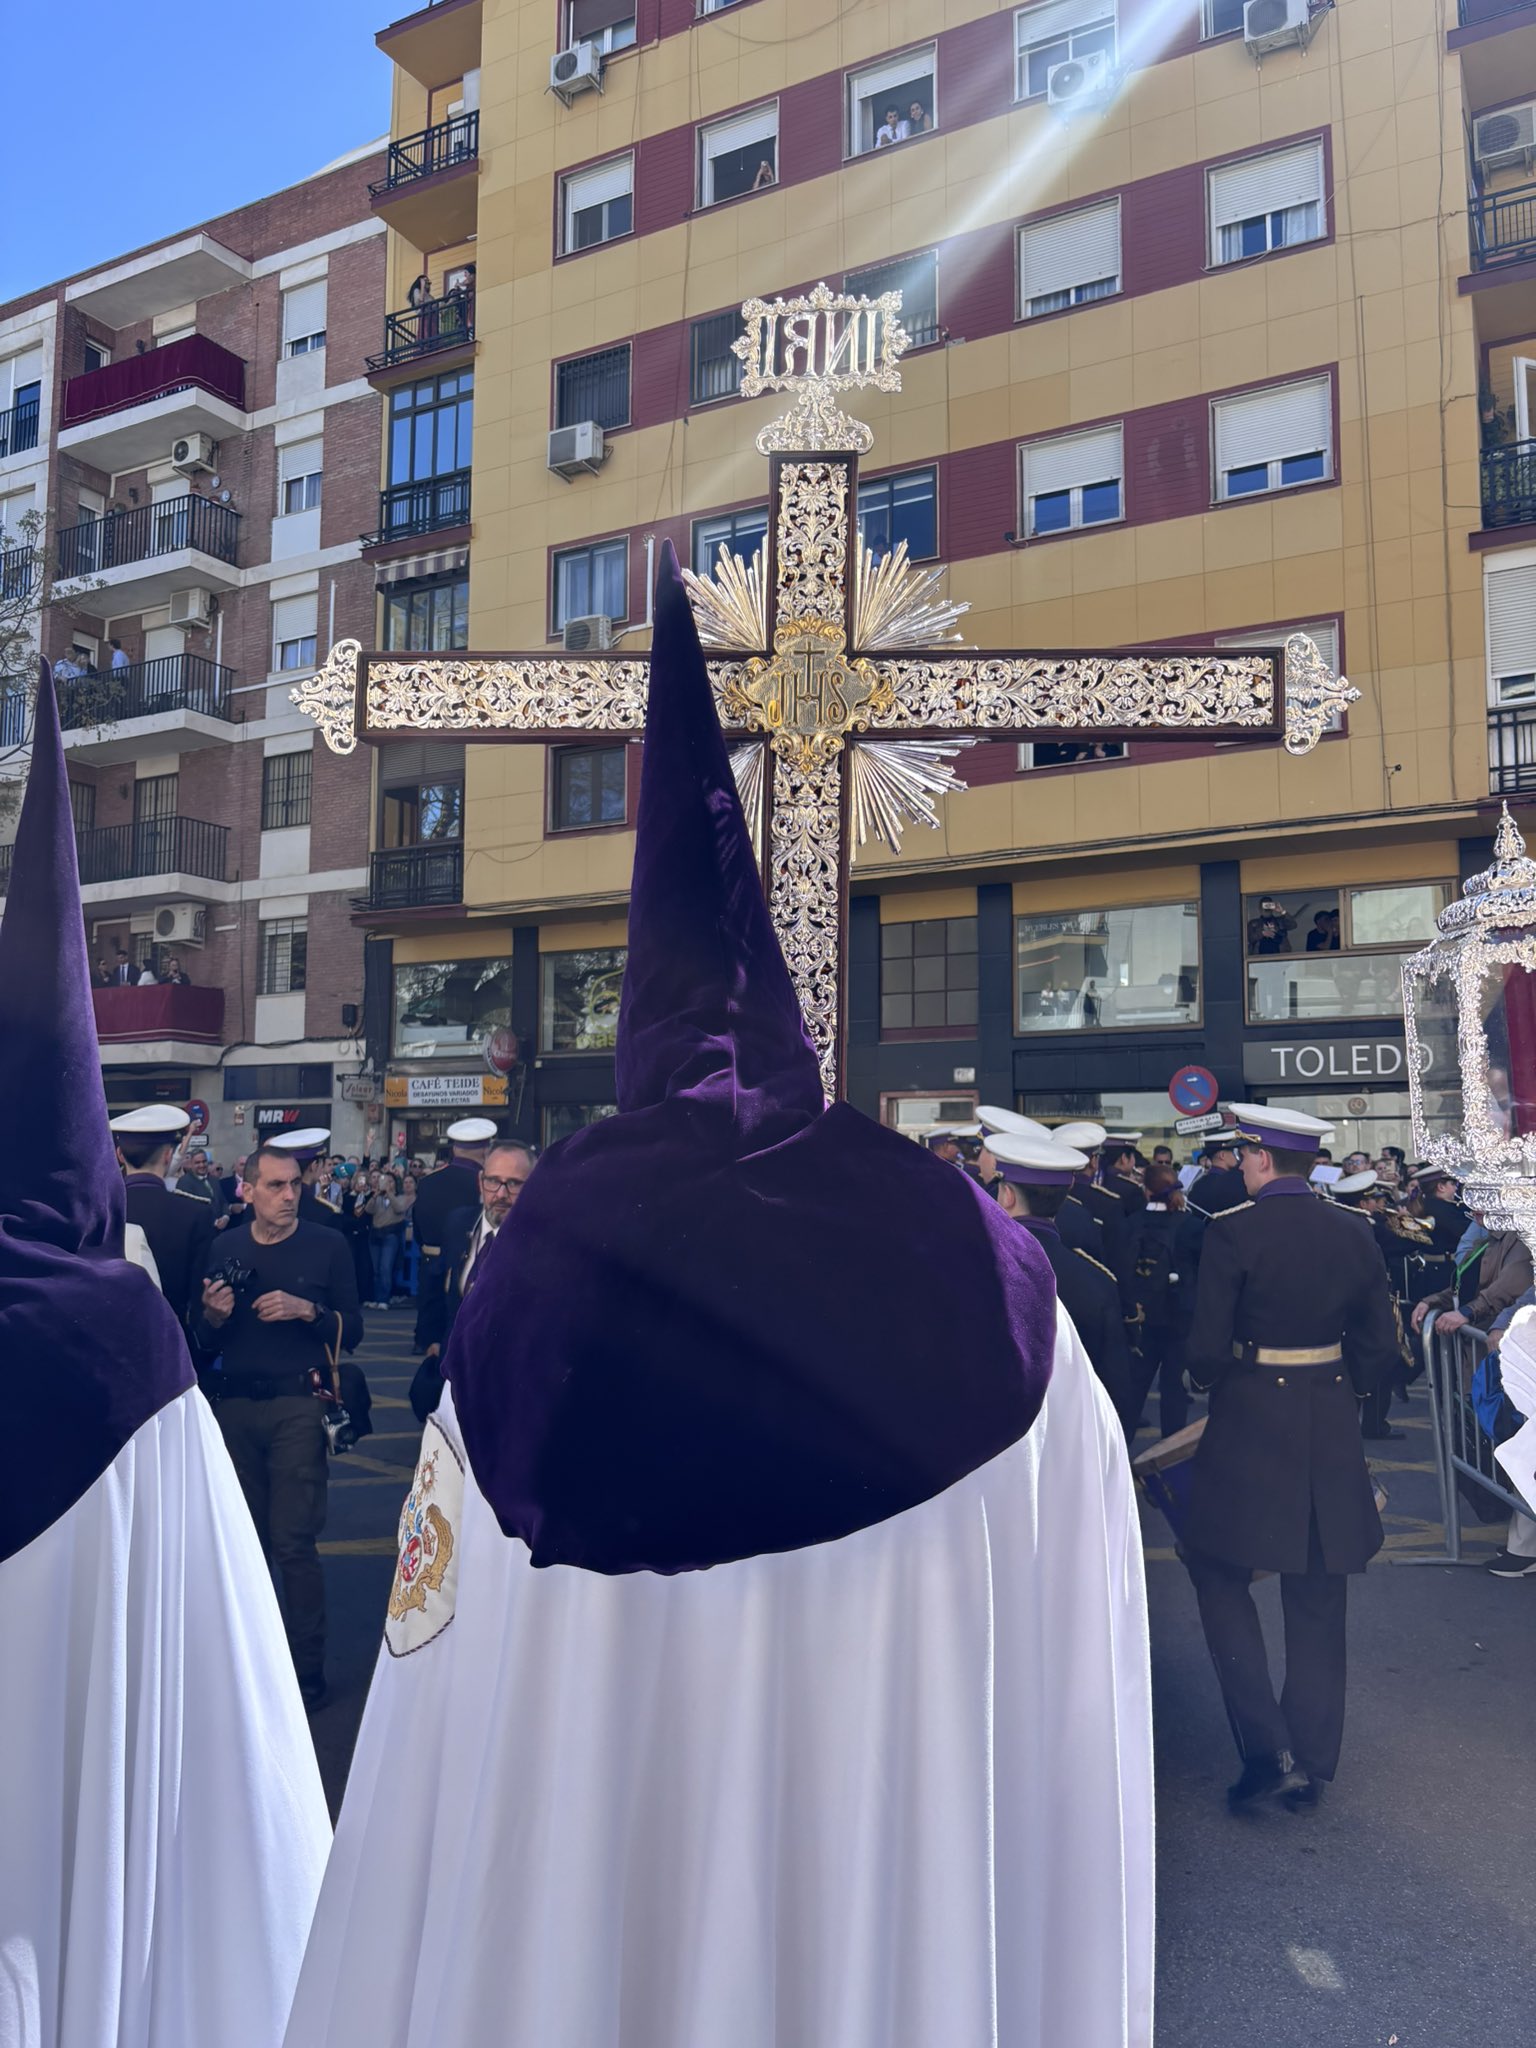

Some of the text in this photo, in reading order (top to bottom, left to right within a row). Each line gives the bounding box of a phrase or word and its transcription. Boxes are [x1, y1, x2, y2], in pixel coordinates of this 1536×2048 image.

[411, 1077, 480, 1090] CAFÉ TEIDE
[413, 1089, 479, 1098] DESAYUNOS VARIADOS
[421, 1097, 439, 1105] TAPAS
[258, 1109, 299, 1123] MRW
